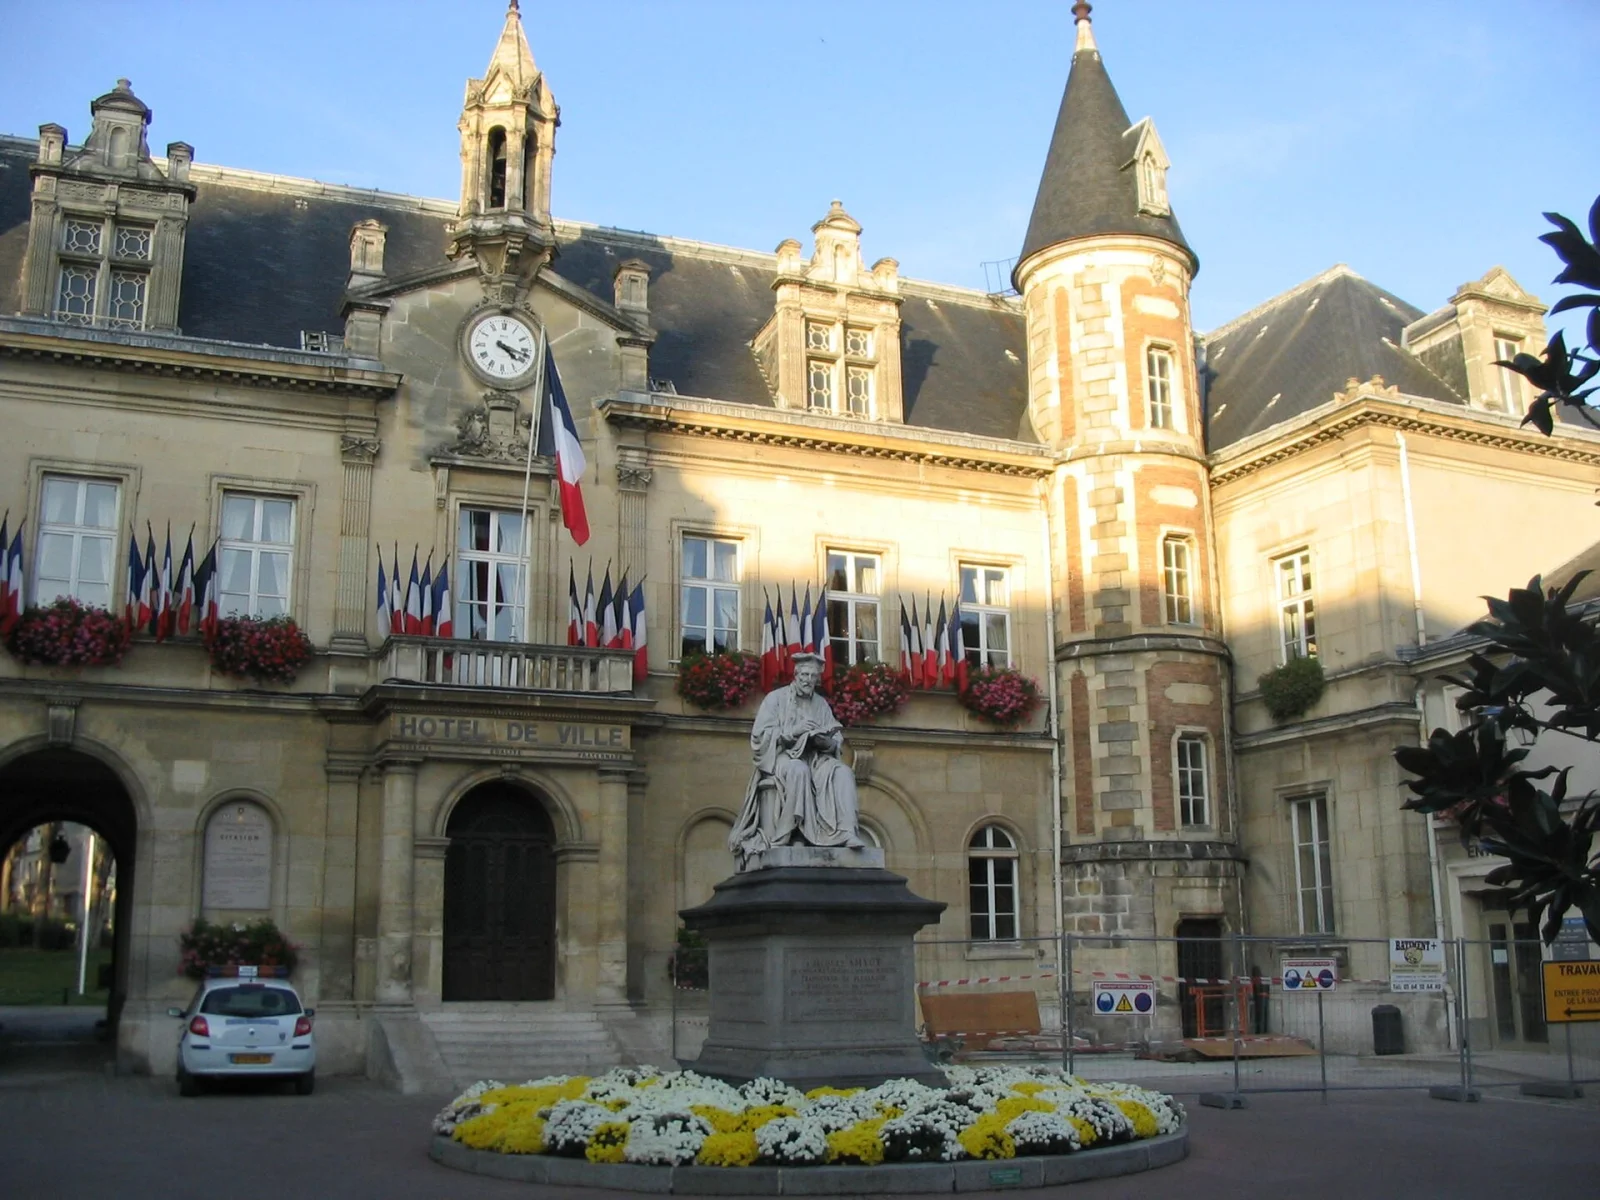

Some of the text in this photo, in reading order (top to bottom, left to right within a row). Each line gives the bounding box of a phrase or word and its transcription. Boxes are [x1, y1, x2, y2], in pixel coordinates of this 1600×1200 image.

[400, 716, 623, 746] HOTEL DE VILLE
